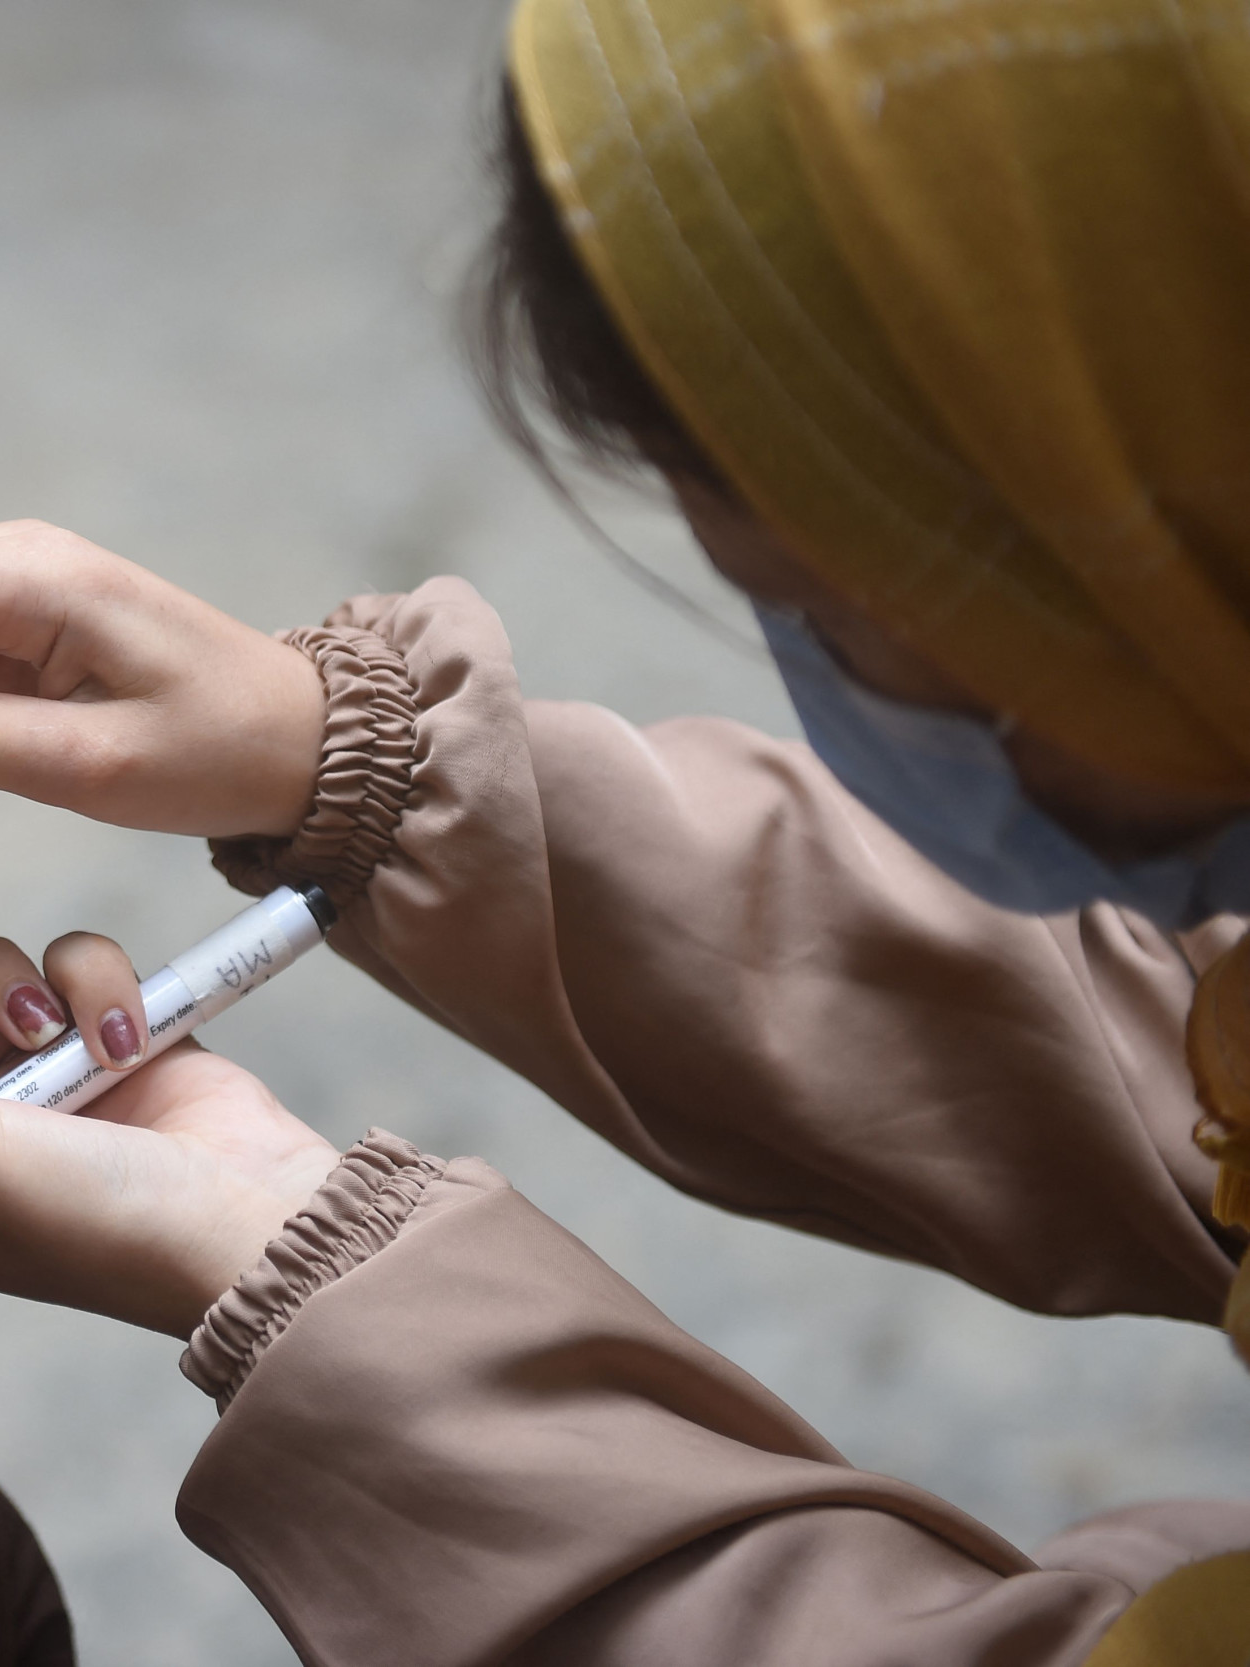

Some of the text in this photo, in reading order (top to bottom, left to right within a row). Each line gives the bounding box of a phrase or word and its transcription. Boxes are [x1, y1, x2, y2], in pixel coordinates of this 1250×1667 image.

[35, 1031, 80, 1064] 10/05/2023
[47, 1091, 63, 1107] 120
[63, 1079, 84, 1097] days
[83, 1069, 93, 1083] of
[150, 1015, 176, 1037] Expiry
[177, 1001, 198, 1020] date:
[16, 1081, 39, 1101] 2302
